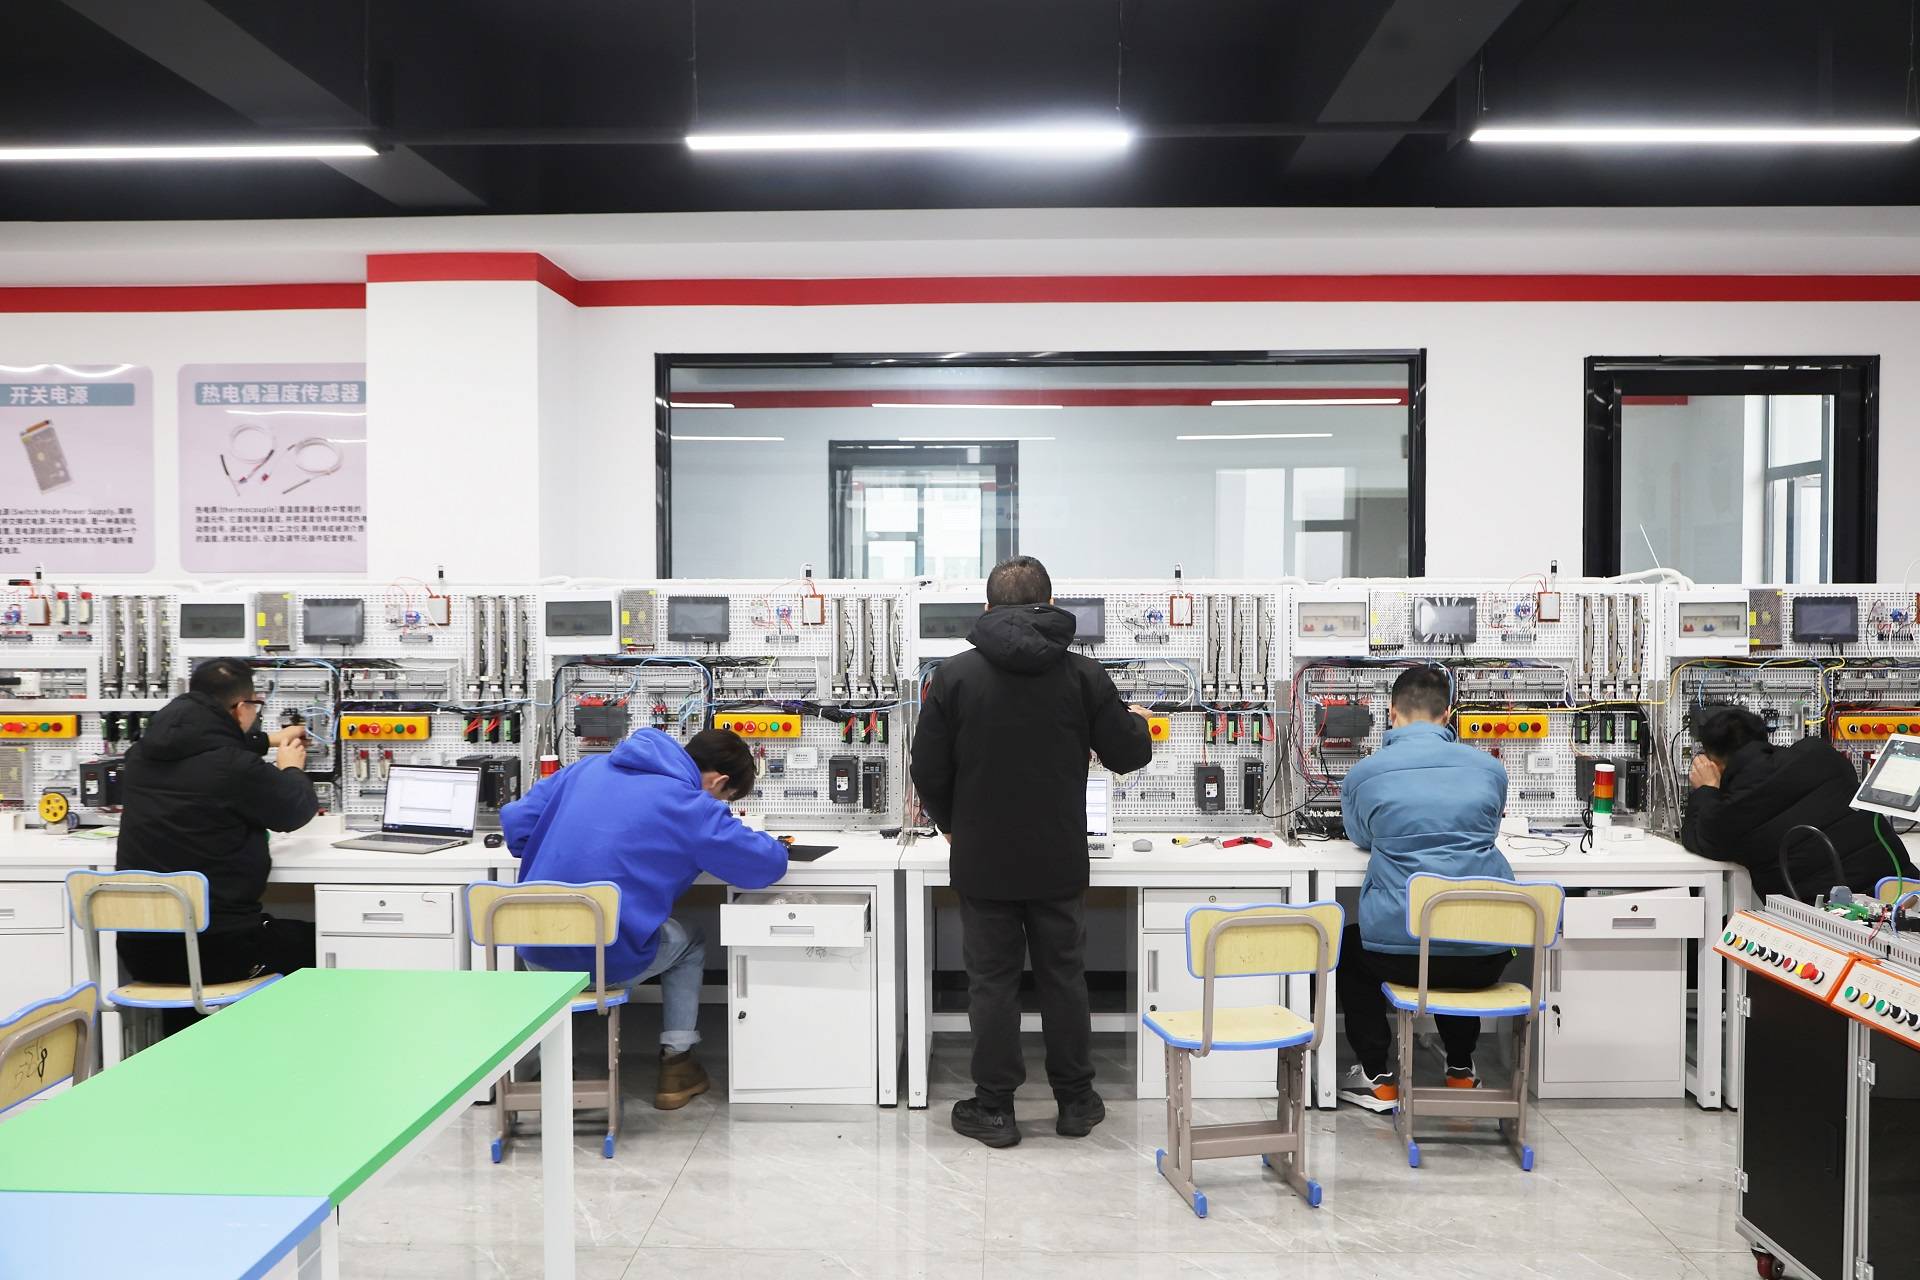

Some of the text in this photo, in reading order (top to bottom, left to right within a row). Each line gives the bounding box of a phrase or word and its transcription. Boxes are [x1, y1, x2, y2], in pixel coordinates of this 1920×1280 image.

[9, 386, 89, 405] 开关电源
[202, 384, 359, 402] 热电偶温度传感器
